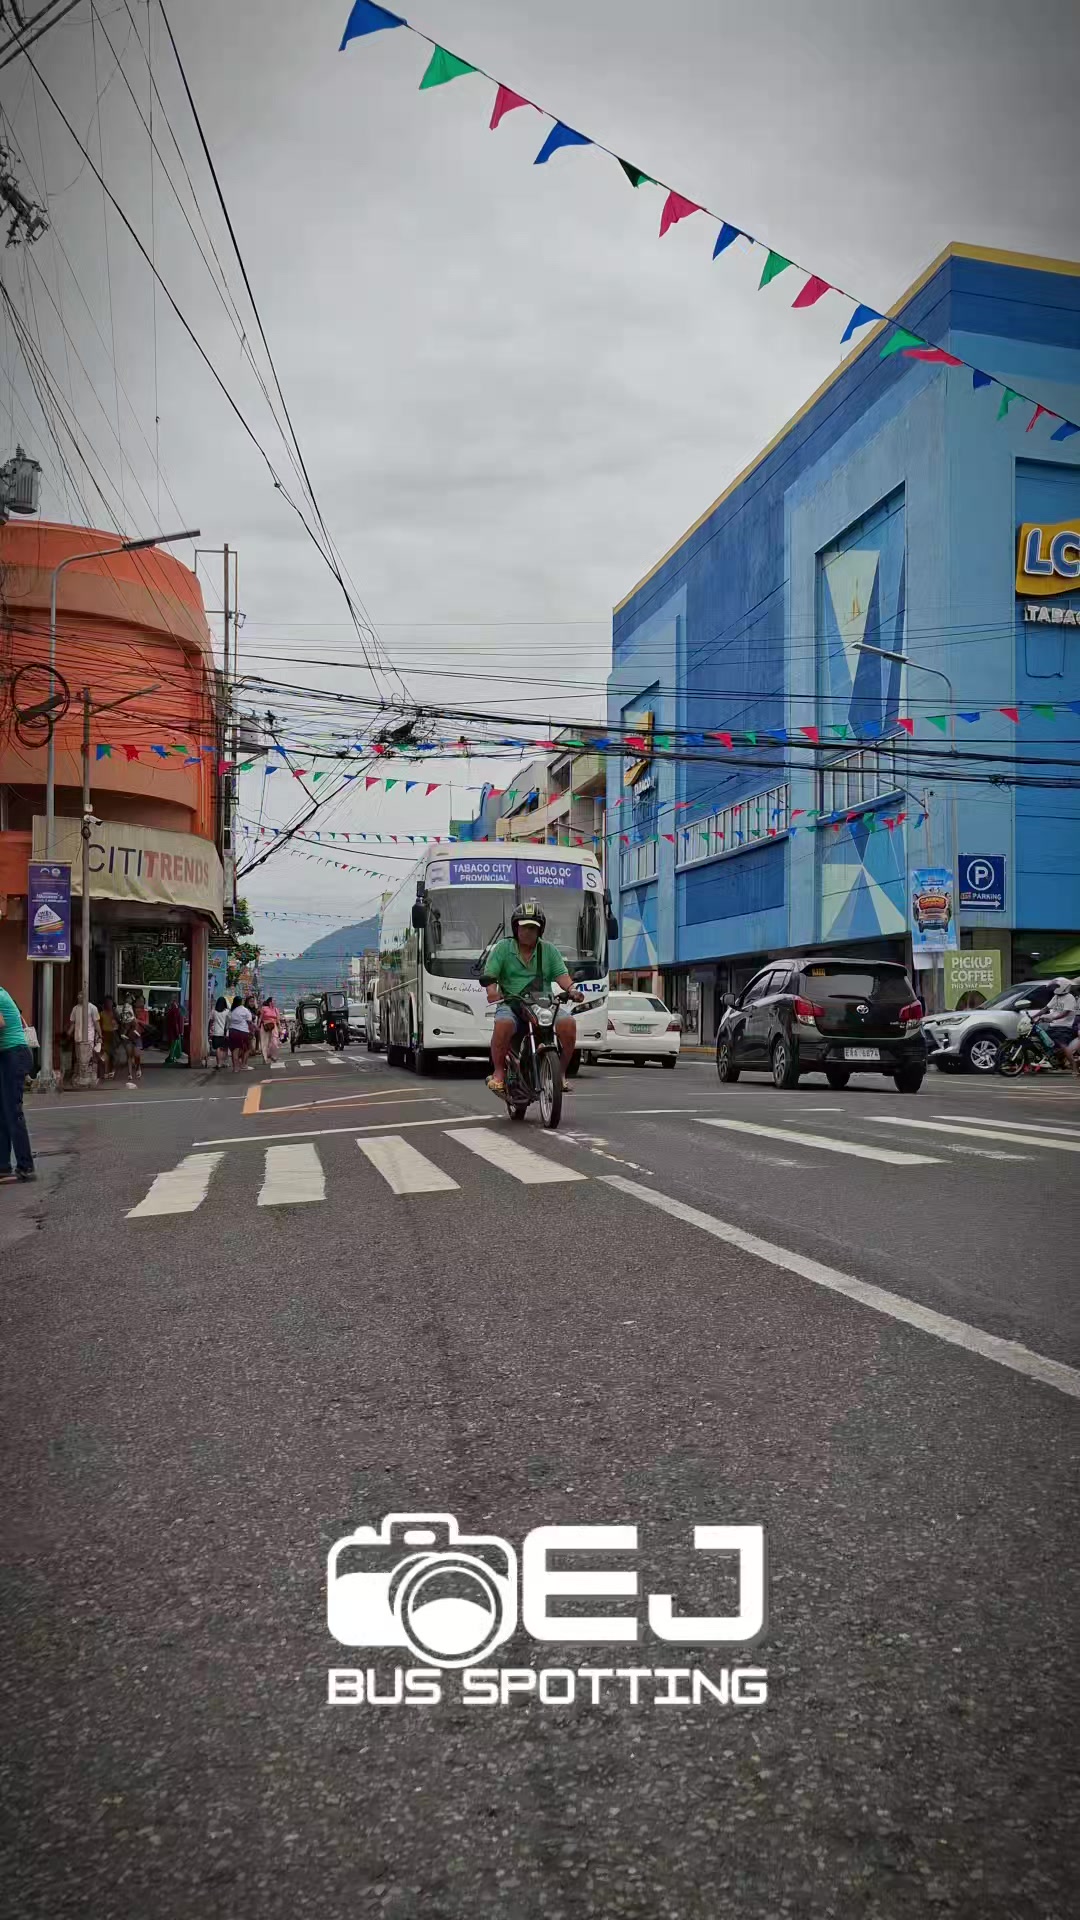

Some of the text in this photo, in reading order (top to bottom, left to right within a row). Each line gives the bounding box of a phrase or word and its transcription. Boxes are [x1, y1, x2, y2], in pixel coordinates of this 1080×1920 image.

[1025, 604, 1080, 625] TABA
[453, 864, 512, 873] TABACO CITY
[526, 865, 572, 877] CUBAO QC
[460, 874, 510, 883] PROVINCIAL
[533, 876, 565, 886] AIRCON
[974, 866, 989, 885] P
[972, 892, 1002, 901] PARKING
[952, 956, 993, 969] PICKUP
[951, 970, 994, 982] COFFEE
